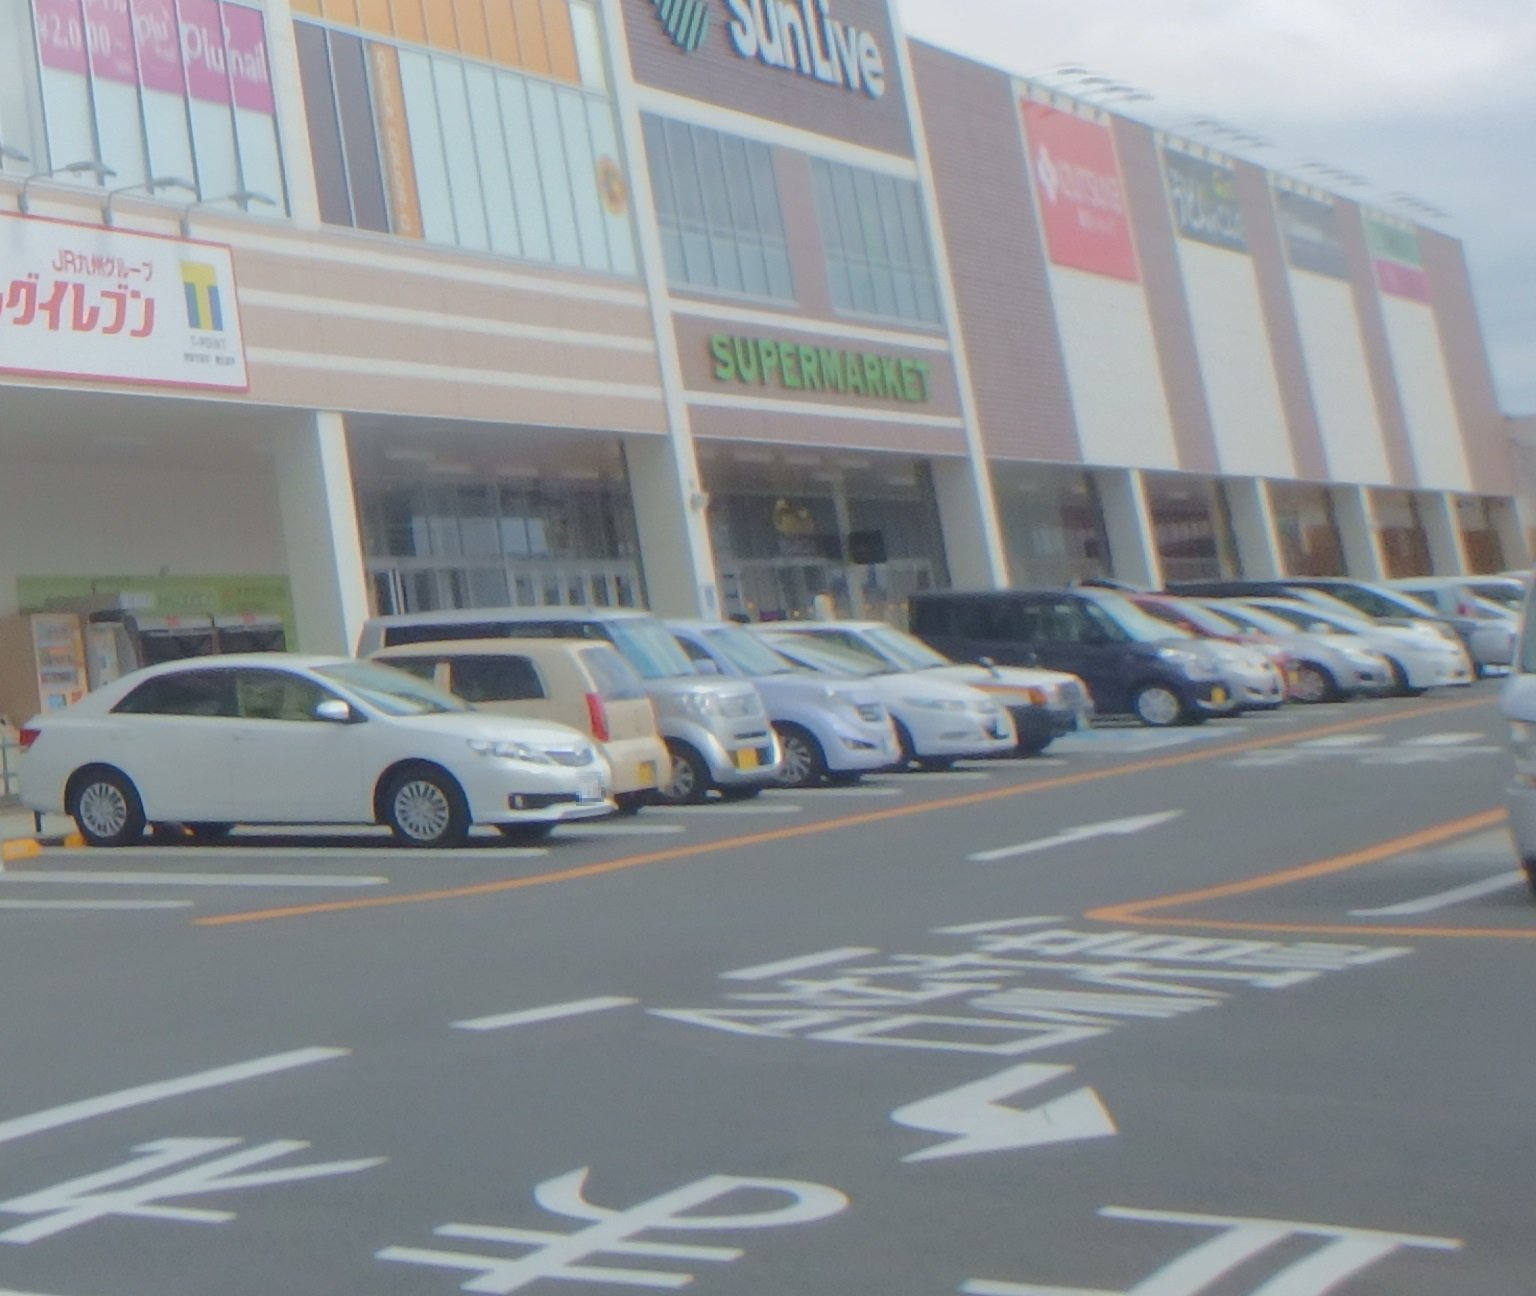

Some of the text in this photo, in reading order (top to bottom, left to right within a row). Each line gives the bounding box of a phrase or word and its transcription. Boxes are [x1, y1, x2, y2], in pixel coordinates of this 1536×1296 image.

[51, 249, 154, 283] JR九州グループ
[709, 332, 934, 404] SUPERMARKET
